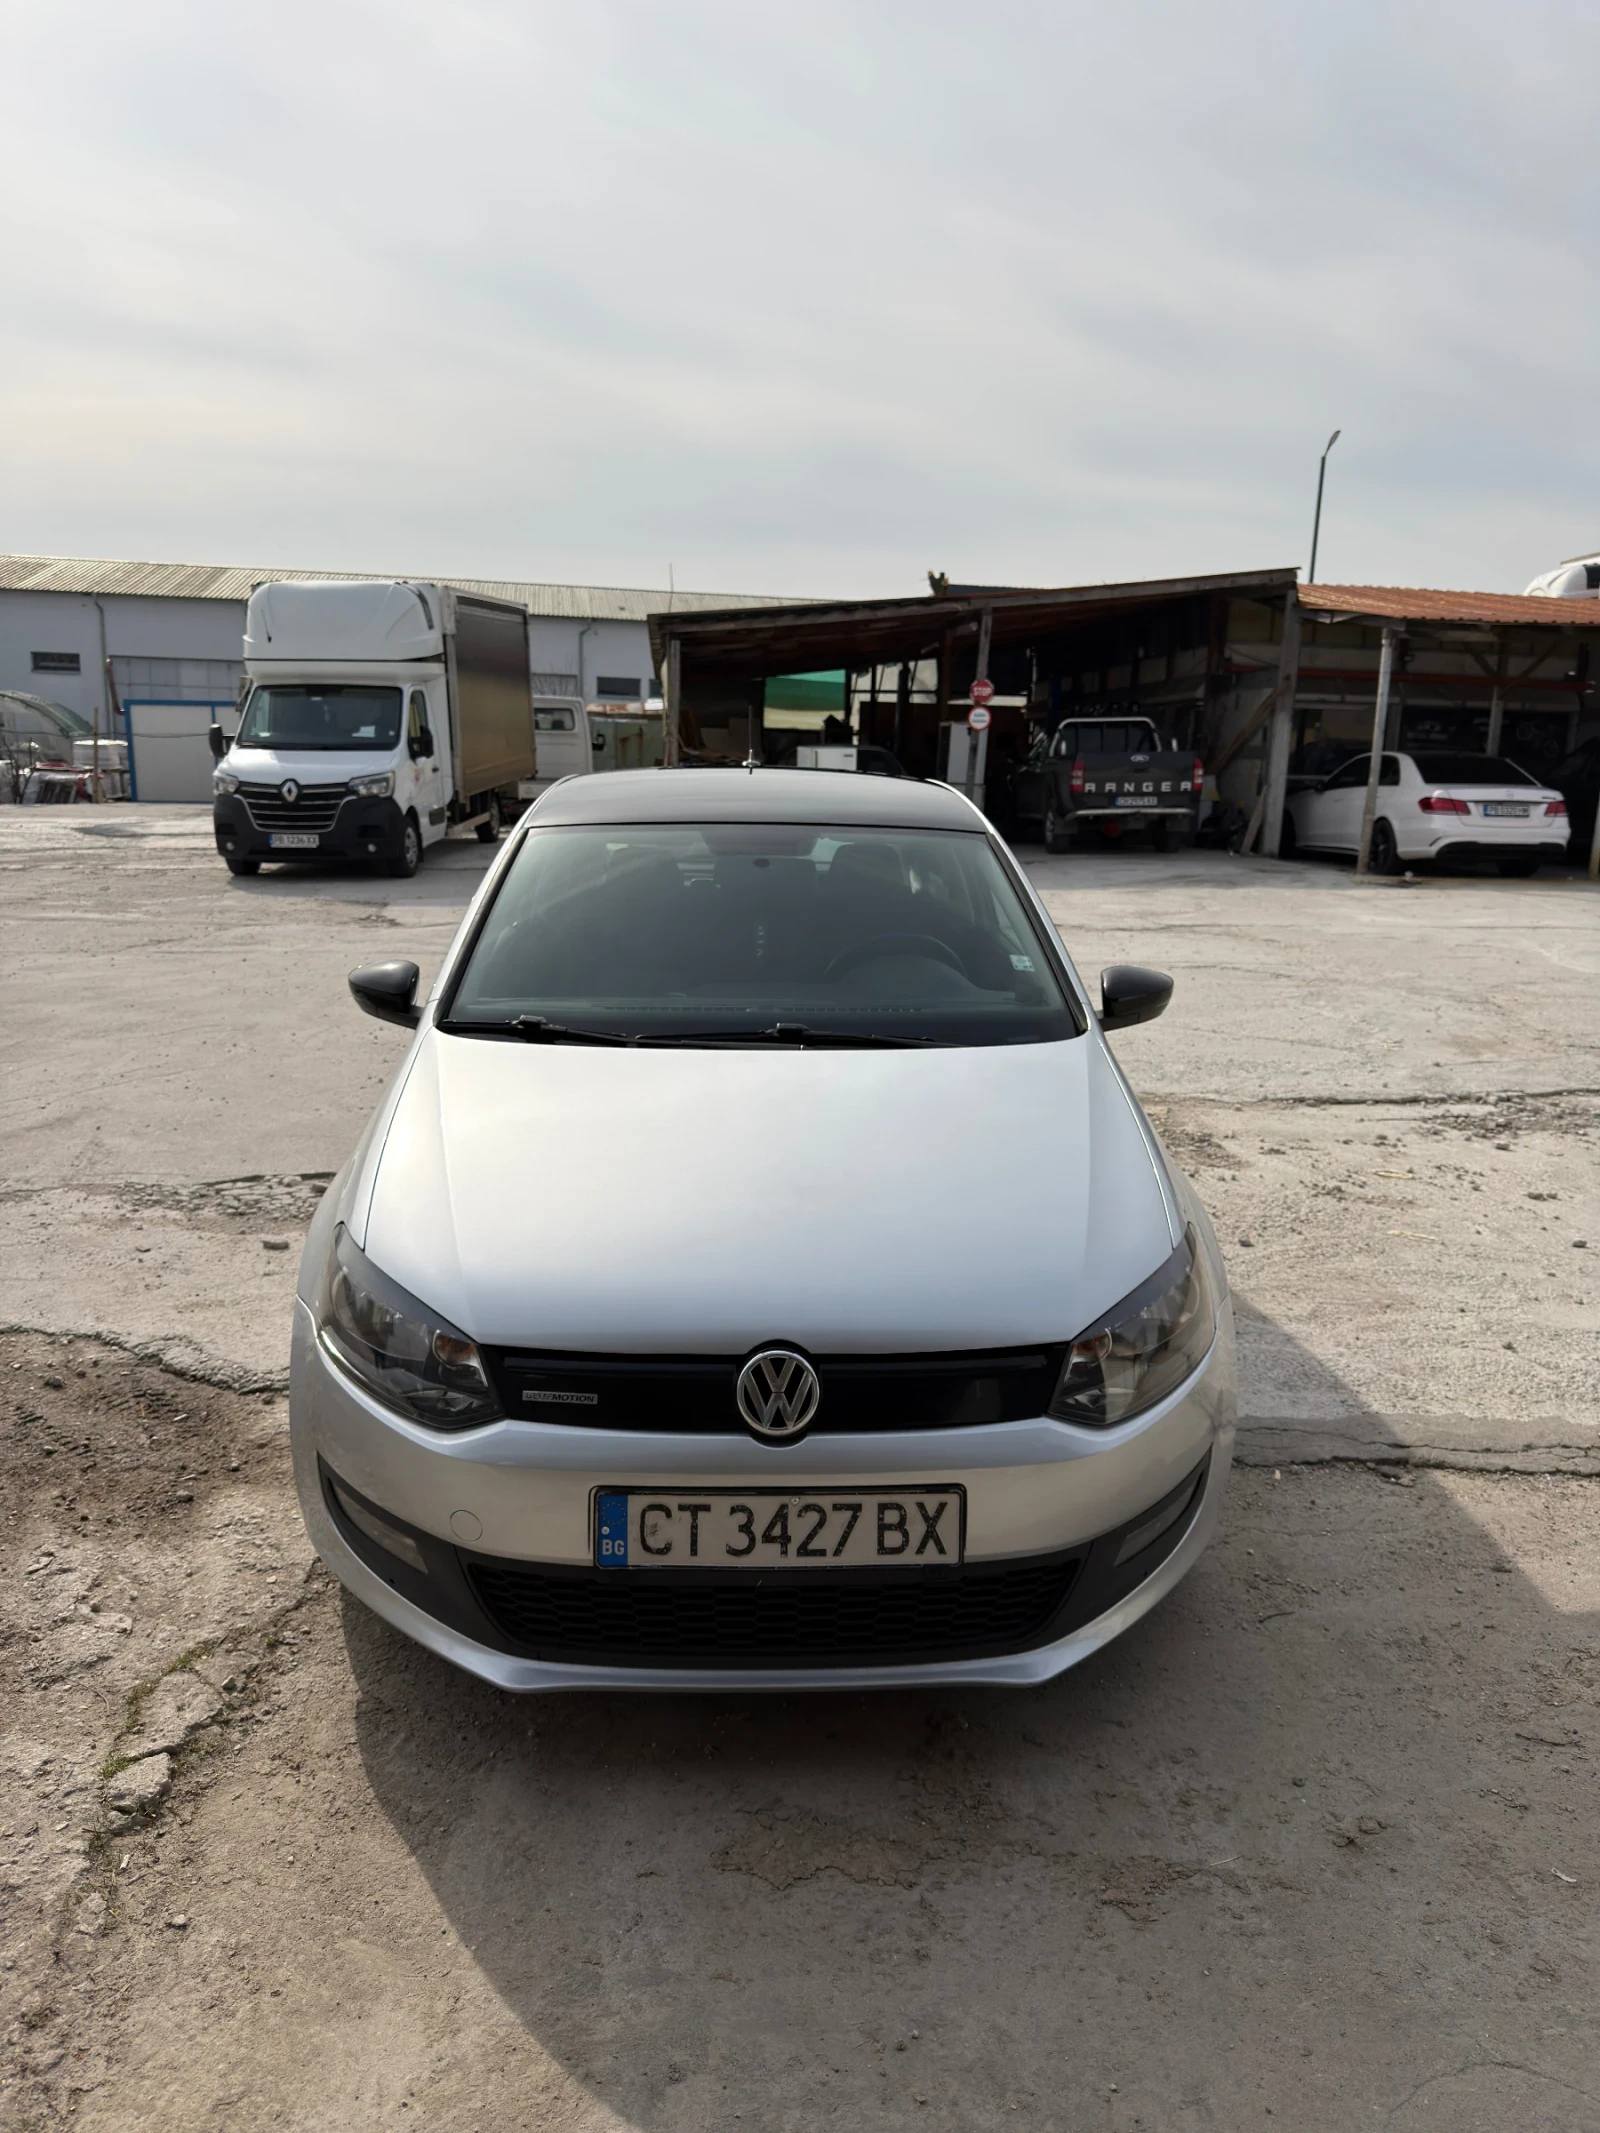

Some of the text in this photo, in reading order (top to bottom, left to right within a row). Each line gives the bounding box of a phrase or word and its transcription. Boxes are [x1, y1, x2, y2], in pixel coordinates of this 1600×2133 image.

[973, 687, 992, 697] STOP
[1084, 781, 1192, 793] RANGER
[639, 1501, 949, 1558] CT 3427 BX
[602, 1539, 625, 1556] BG
